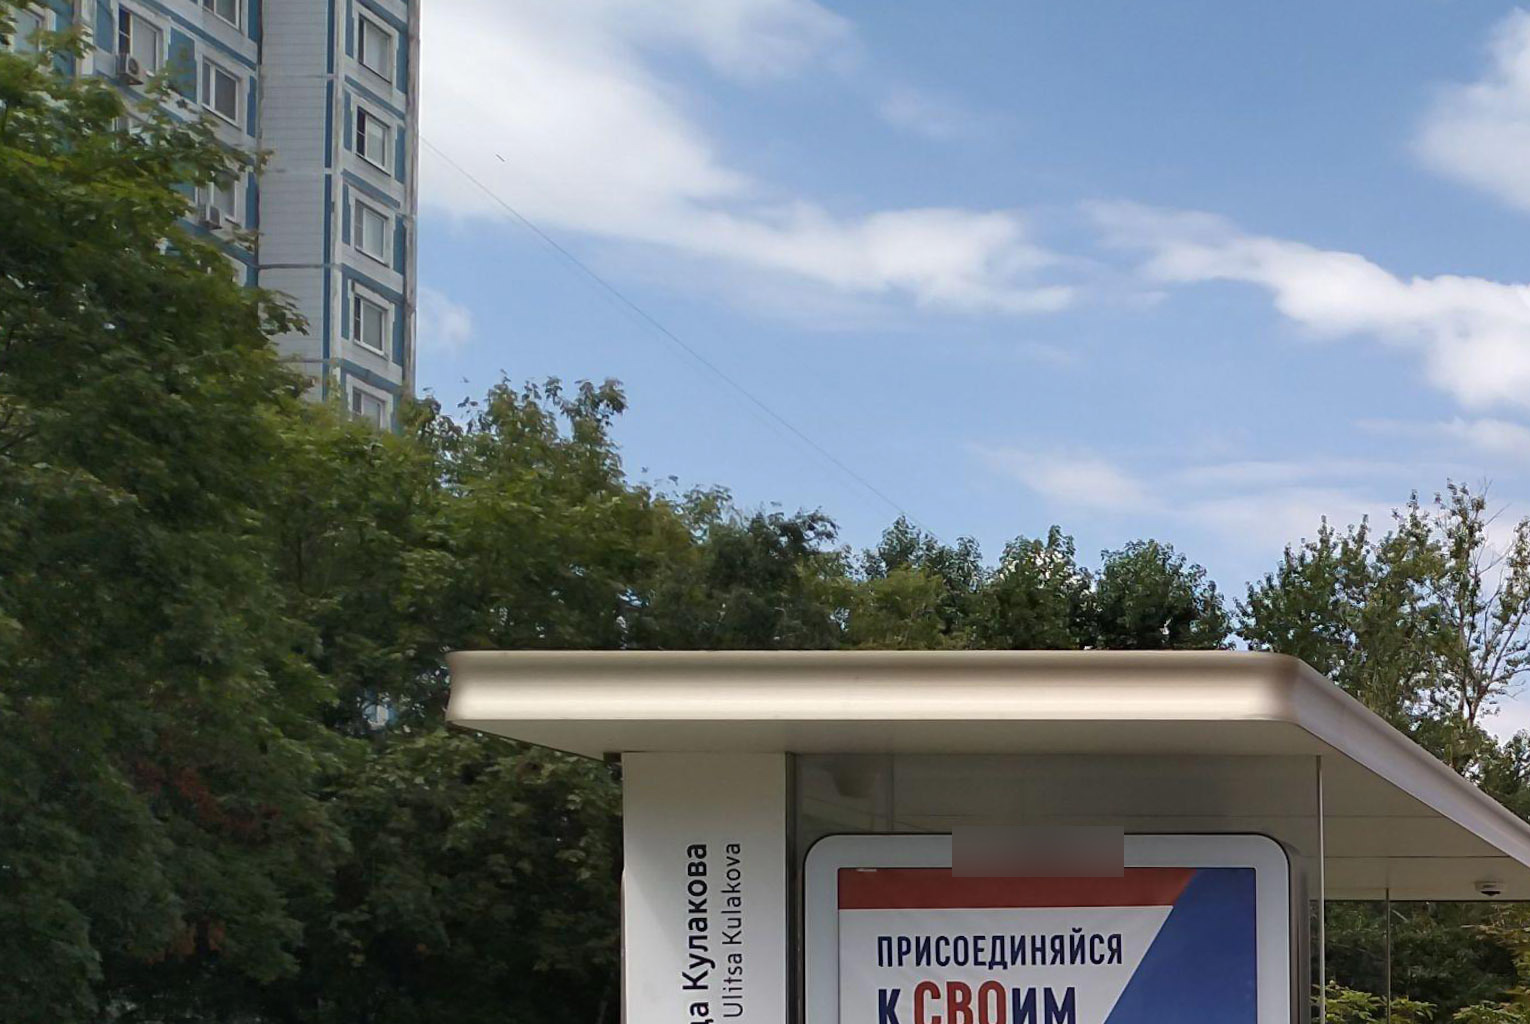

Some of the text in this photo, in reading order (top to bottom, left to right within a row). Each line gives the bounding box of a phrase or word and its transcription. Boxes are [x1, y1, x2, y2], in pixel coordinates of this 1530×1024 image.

[681, 843, 716, 989] Кулакова
[720, 843, 744, 1018] Ulitsa Kulakova
[877, 927, 1123, 971] ПРИСОЕДИНЯЙСЯ
